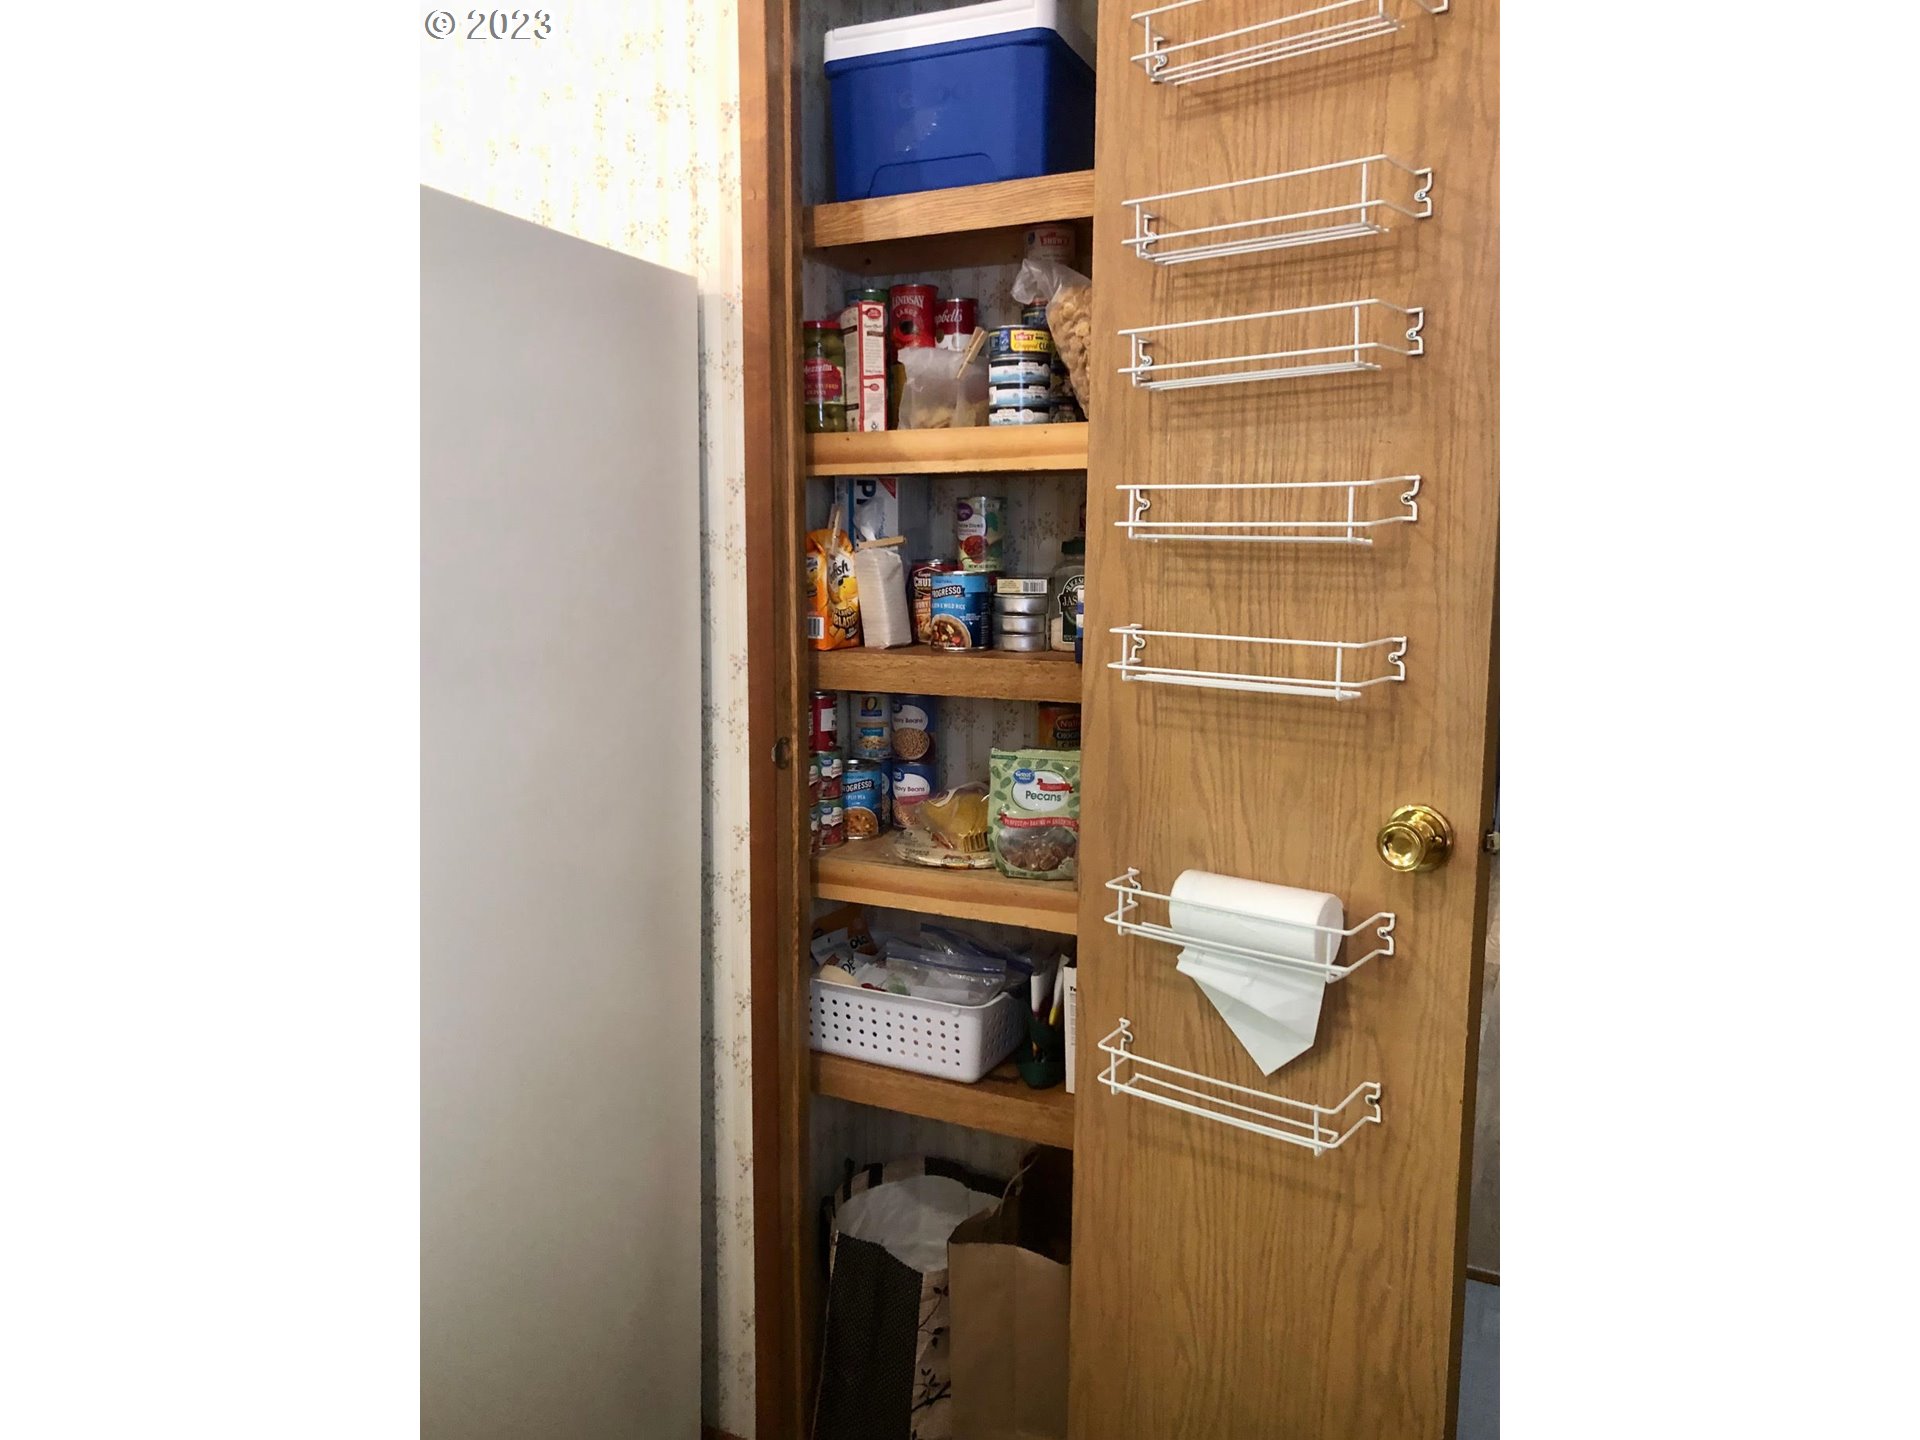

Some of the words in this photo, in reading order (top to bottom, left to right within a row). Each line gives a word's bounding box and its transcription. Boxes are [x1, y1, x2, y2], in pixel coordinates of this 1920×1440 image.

[891, 295, 925, 309] LINDSAY
[907, 785, 925, 793] Beans
[1025, 790, 1062, 802] Pecans
